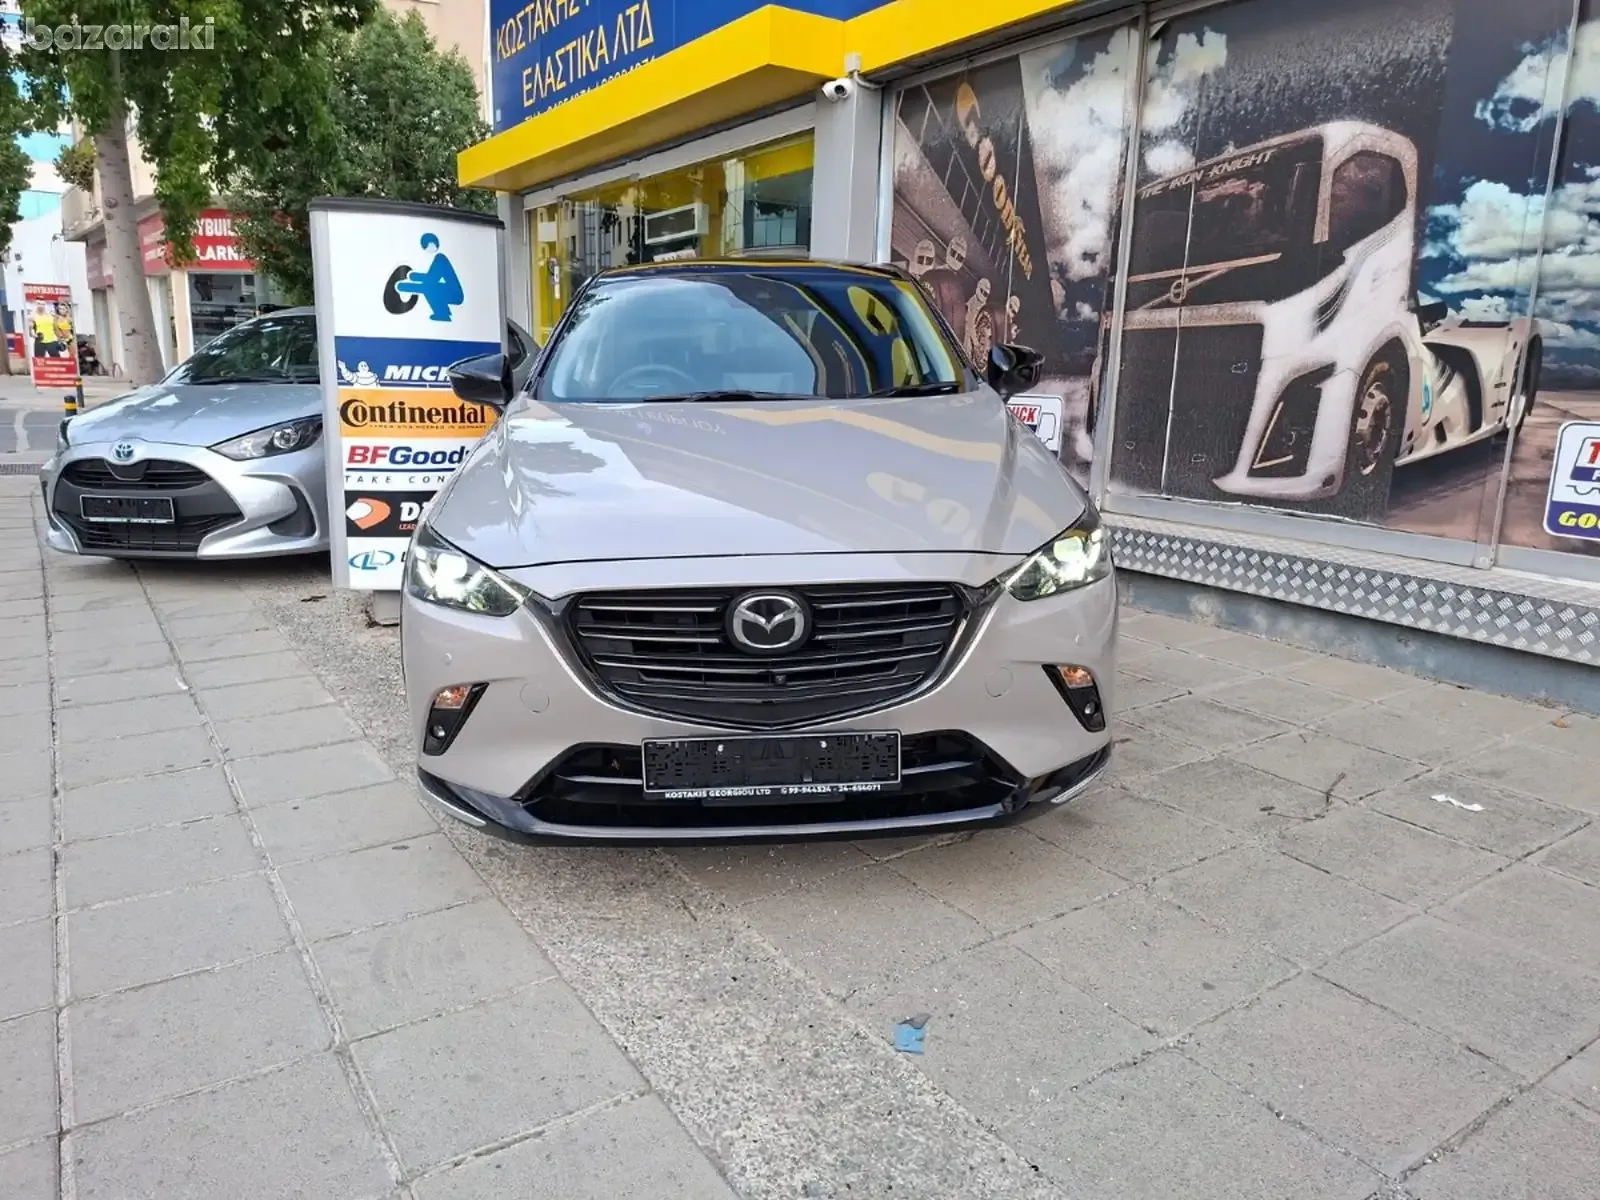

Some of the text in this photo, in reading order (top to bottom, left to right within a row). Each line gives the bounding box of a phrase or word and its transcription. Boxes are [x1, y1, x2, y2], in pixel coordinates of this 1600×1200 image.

[523, 25, 609, 107] ΕΛΑΣΤΙΚΑ
[613, 0, 654, 61] ΛΤΔ
[1209, 149, 1276, 178] KNIGHT
[340, 399, 486, 427] Continental
[347, 445, 469, 465] BFGood
[345, 475, 392, 485] TAKE
[1559, 511, 1600, 530] GO
[665, 790, 707, 799] KOSTAKIS
[709, 788, 754, 797] GEORGIOU
[756, 788, 771, 796] LTD
